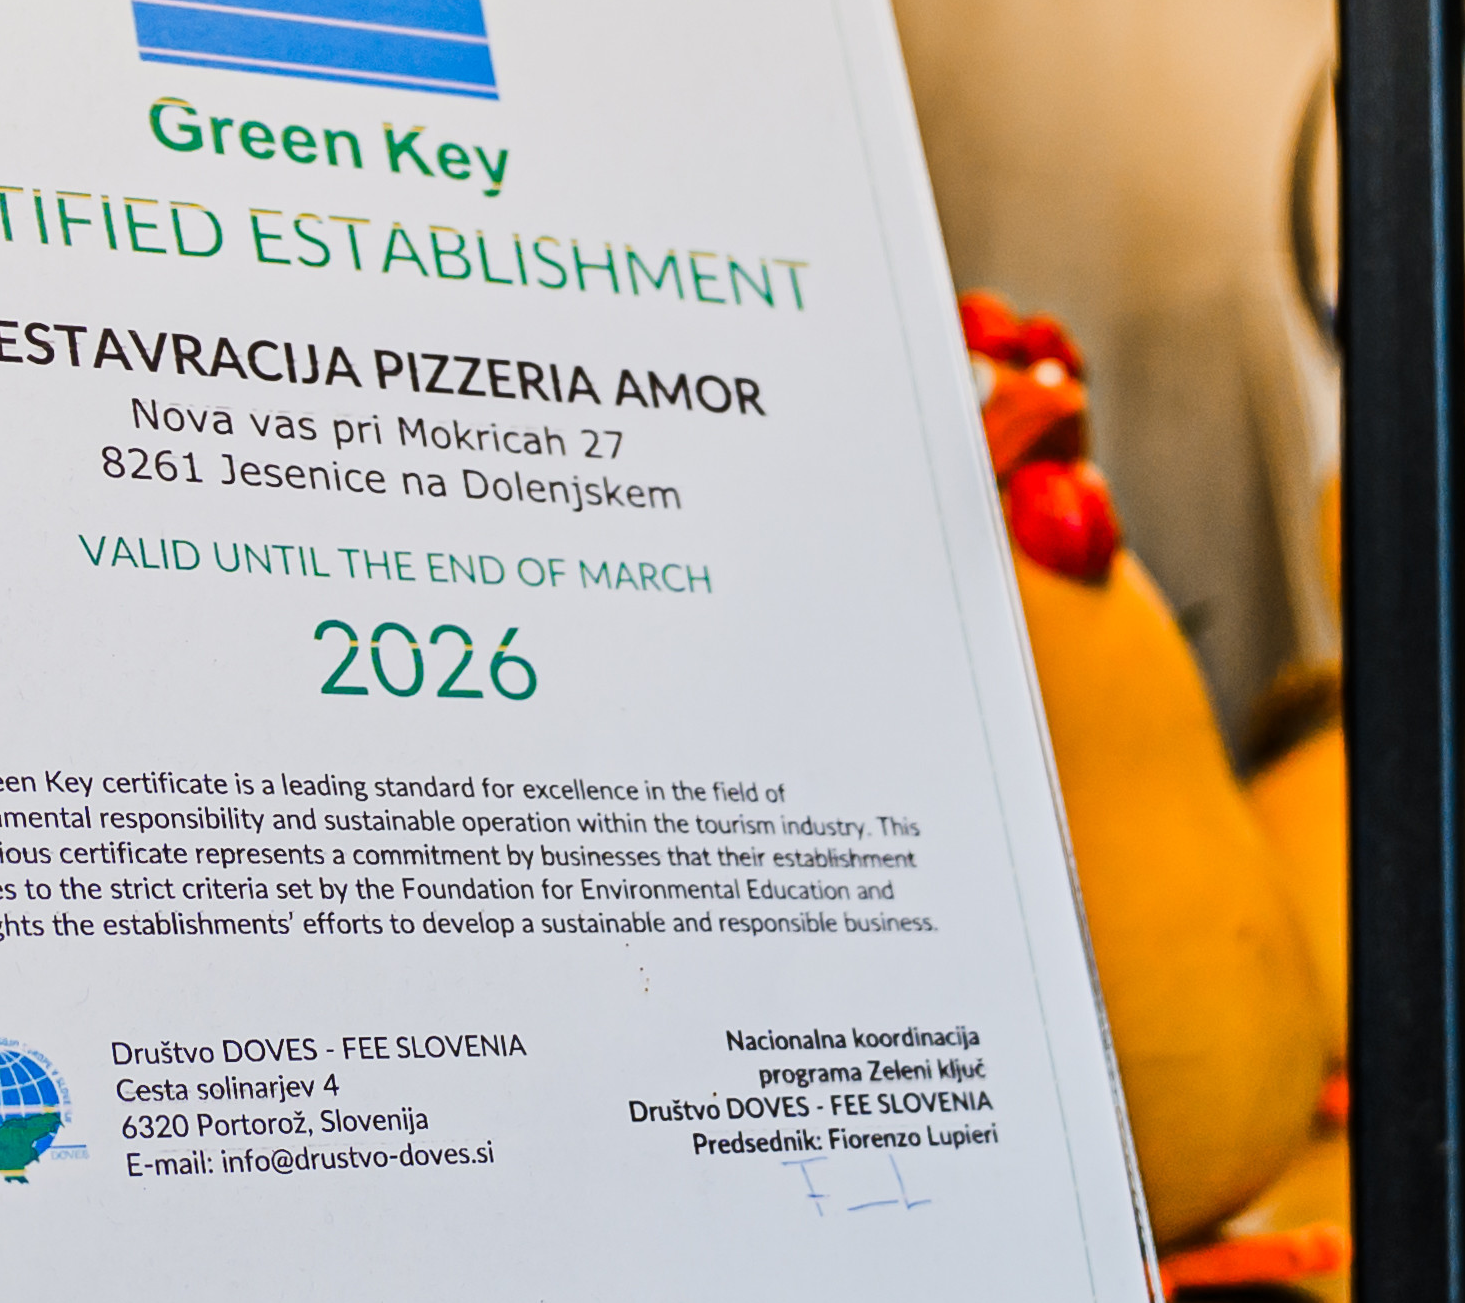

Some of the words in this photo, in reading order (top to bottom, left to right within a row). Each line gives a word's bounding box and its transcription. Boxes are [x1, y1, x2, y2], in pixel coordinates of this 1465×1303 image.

[148, 96, 364, 170] Green
[382, 121, 509, 199] Key
[248, 207, 809, 312] ESTABLISHMENT
[373, 349, 602, 406] PIZZERIA
[615, 368, 767, 417] AMOR
[131, 397, 234, 436] Nova
[249, 413, 318, 441] vas
[332, 414, 382, 451] pri
[397, 416, 567, 457] Mokricah
[580, 428, 623, 460] 27
[101, 445, 204, 484] 8261
[220, 453, 387, 495] Jesenice
[401, 472, 448, 498] na
[462, 468, 682, 513] Dolenjskem
[77, 533, 201, 571] VALID
[212, 541, 331, 578] UNTIL
[336, 547, 417, 582] THE
[426, 552, 506, 586] END
[516, 556, 566, 588] OF
[578, 559, 713, 594] MARCH
[313, 618, 538, 702] 2026
[44, 769, 94, 798] Key
[102, 770, 229, 795] certificate
[233, 772, 255, 796] is
[261, 778, 276, 796] a
[280, 772, 369, 802] leading
[373, 775, 476, 799] standard
[481, 776, 515, 799] for
[522, 778, 640, 802] excellence
[643, 779, 666, 801] in
[670, 779, 707, 802] the
[711, 781, 760, 803] field
[765, 783, 786, 804] of
[99, 805, 265, 835] responsibility
[272, 807, 317, 831] and
[323, 808, 456, 832] sustainable
[461, 810, 572, 837] operation
[576, 811, 648, 834] within
[653, 812, 690, 835] the
[695, 813, 776, 835] tourism
[780, 814, 865, 841] industry.
[876, 815, 921, 837] This
[59, 840, 189, 865] certificate
[195, 843, 325, 870] represents
[332, 848, 346, 866] a
[352, 843, 502, 866] commitment
[506, 843, 534, 871] by
[540, 843, 662, 867] businesses
[666, 845, 713, 867] that
[716, 845, 766, 868] their
[772, 847, 918, 869] establishment
[23, 878, 52, 901] to
[58, 875, 103, 901] the
[109, 876, 177, 900] strict
[182, 876, 269, 900] criteria
[275, 878, 314, 900] set
[318, 876, 349, 905] by
[354, 876, 395, 900] the
[401, 876, 535, 900] Foundation
[540, 877, 574, 900] for
[580, 877, 741, 901] Environmental
[746, 878, 851, 901] Education
[857, 879, 895, 901] and
[51, 911, 95, 937] the
[102, 910, 294, 936] establishments’
[302, 910, 384, 935] efforts
[388, 913, 416, 935] to
[422, 910, 515, 939] develop
[521, 917, 535, 934] a
[540, 910, 667, 934] sustainable
[672, 910, 713, 933] and
[718, 911, 838, 938] responsible
[843, 911, 939, 933] business.
[111, 1040, 215, 1066] Društvo
[222, 1037, 318, 1063] DOVES
[342, 1036, 391, 1060] FEE
[395, 1033, 528, 1059] SLOVENIA
[725, 1028, 848, 1052] Nacionalna
[851, 1025, 981, 1051] koordinacija
[116, 1078, 189, 1103] Cesta
[196, 1074, 315, 1104] solinarjev
[322, 1073, 340, 1097] 4
[758, 1066, 863, 1090] programa
[866, 1058, 933, 1083] Zeleni
[936, 1057, 987, 1084] ključ
[121, 1113, 190, 1140] 6320
[196, 1110, 314, 1138] Portorož,
[320, 1106, 429, 1136] Slovenija
[628, 1097, 721, 1123] Društvo
[725, 1095, 810, 1120] DOVES
[829, 1093, 873, 1117] FEE
[876, 1090, 994, 1115] SLOVENIA
[692, 1128, 824, 1156] Predsednik:
[827, 1127, 922, 1150] Fiorenzo
[926, 1122, 999, 1151] Lupieri
[126, 1149, 214, 1177] E-mail:
[220, 1139, 495, 1175] info@drustvo-doves.si
